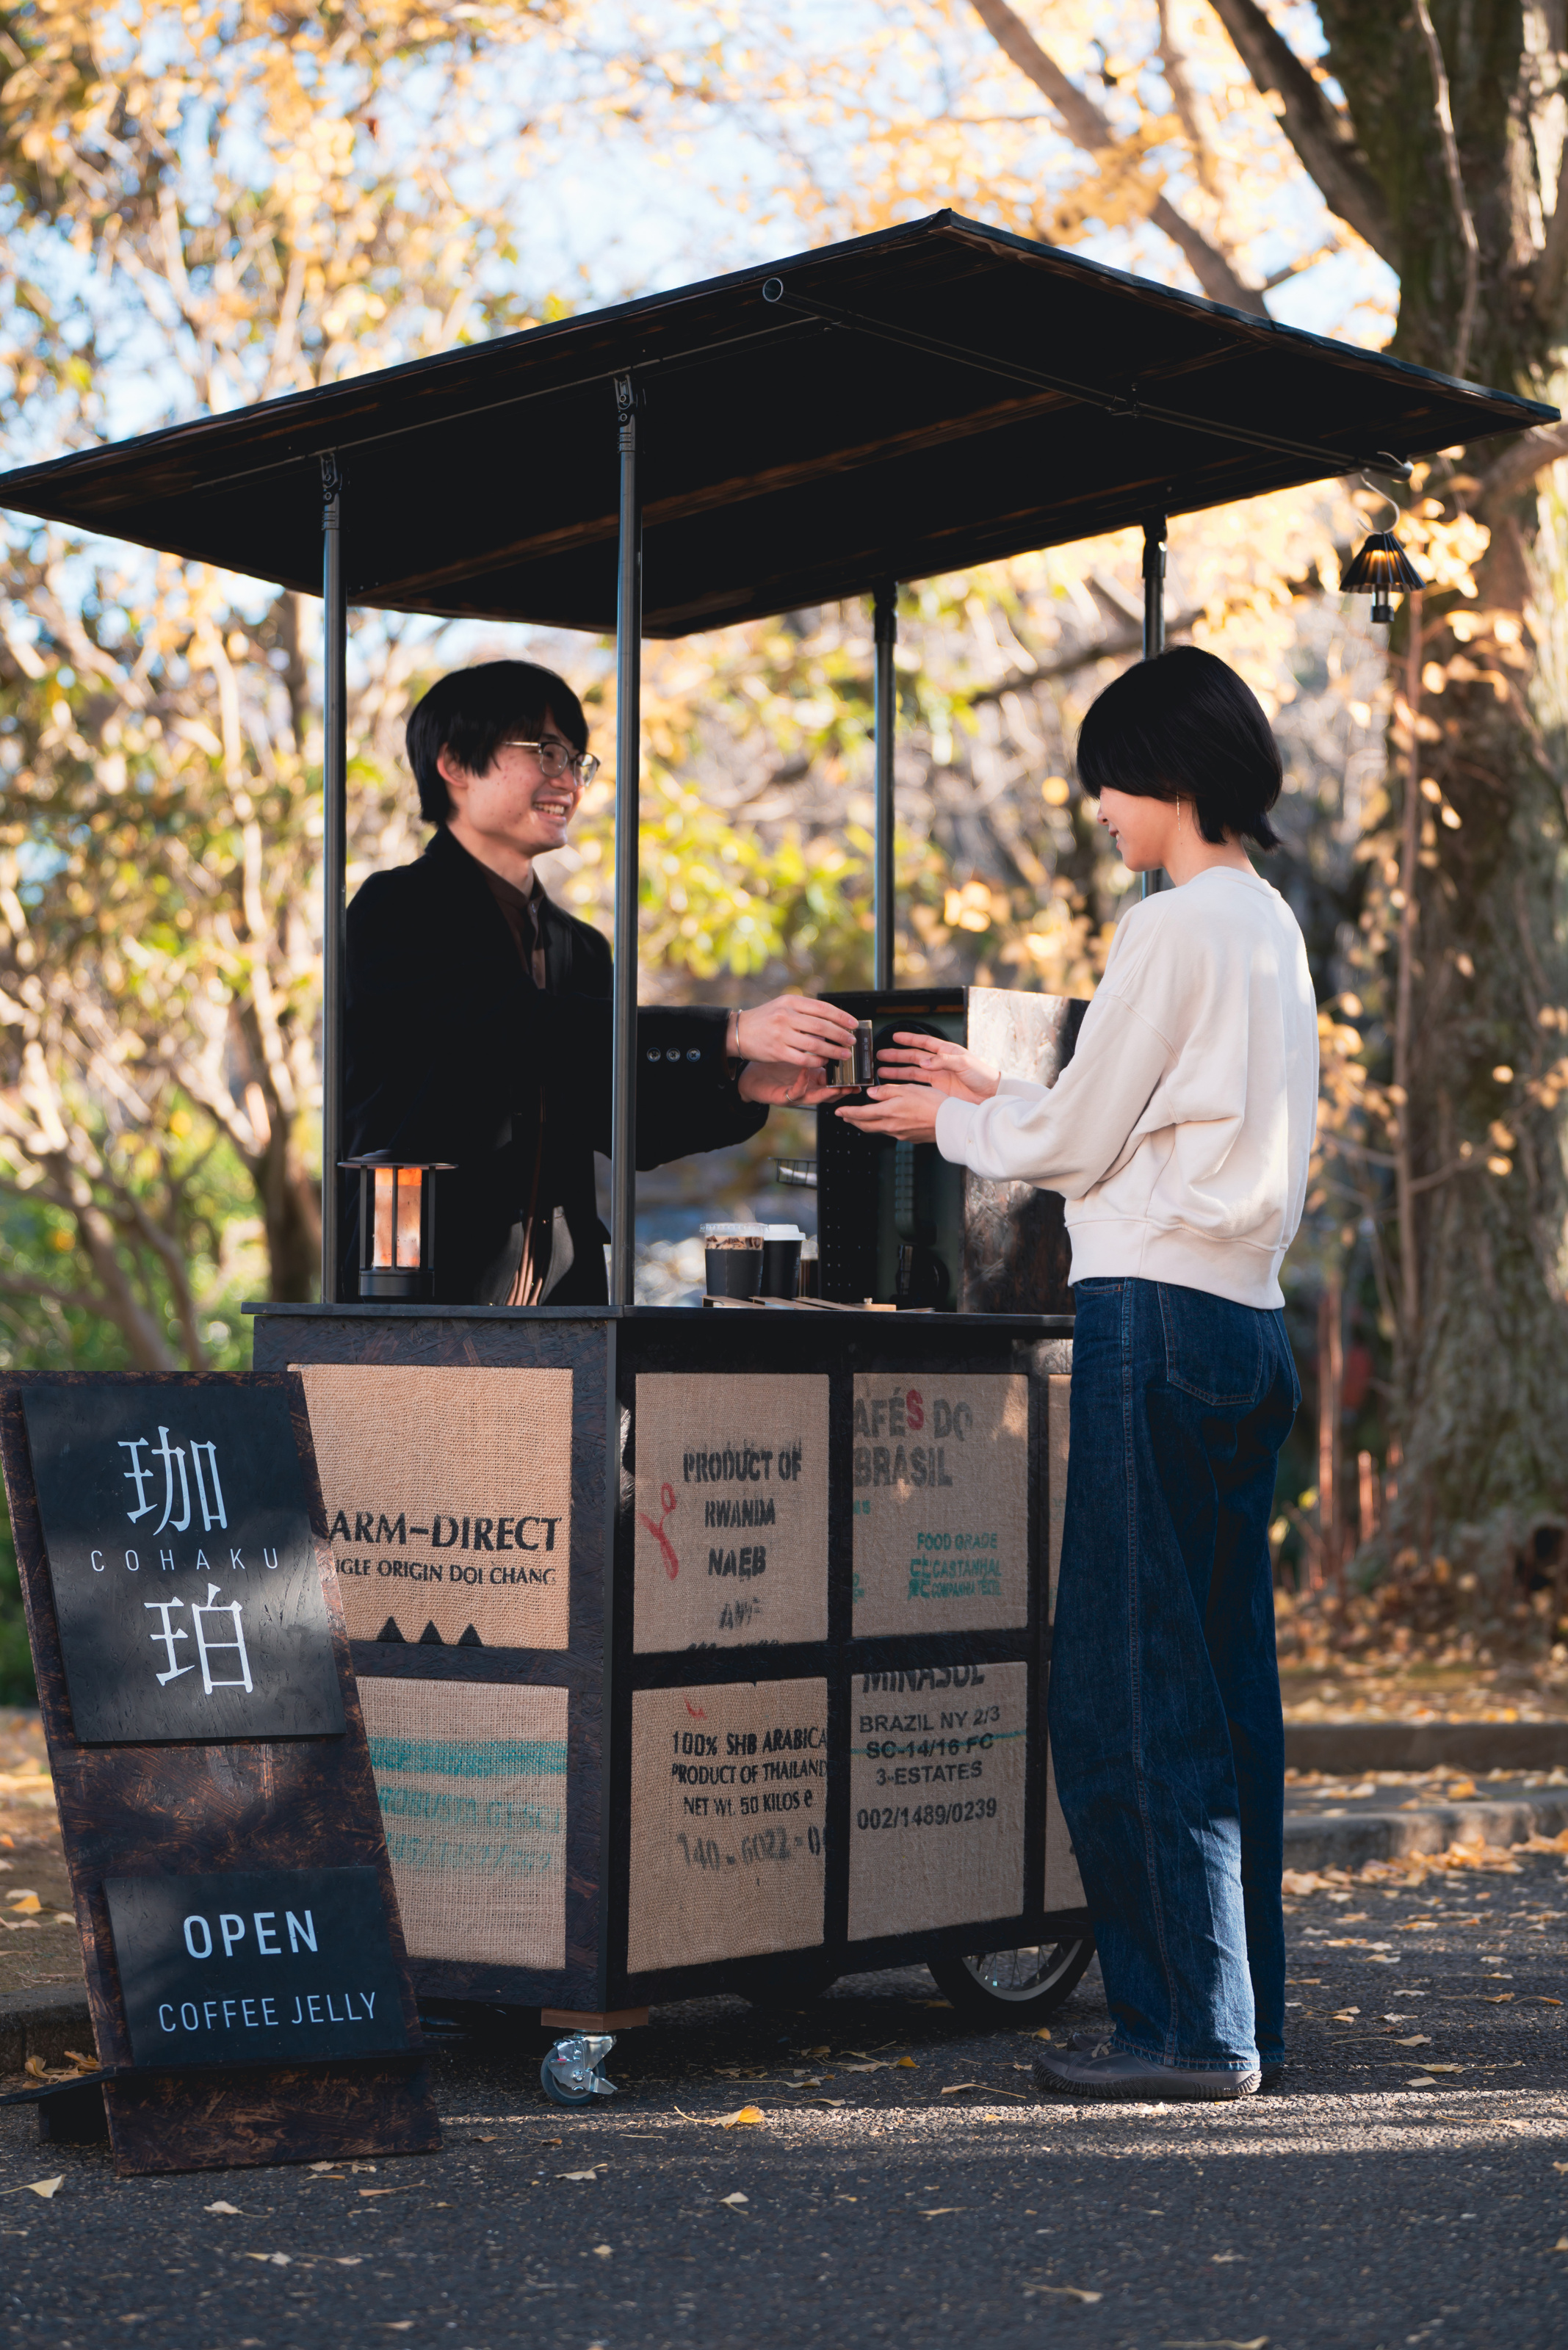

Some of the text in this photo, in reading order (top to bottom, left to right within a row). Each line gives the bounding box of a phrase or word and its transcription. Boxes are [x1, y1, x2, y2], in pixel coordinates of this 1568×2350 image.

[683, 1448, 802, 1482] PRODUCT OF
[853, 1445, 953, 1487] BRASIL
[118, 1425, 228, 1536] 珈
[325, 1508, 562, 1551] ARM-DIRECT
[917, 1532, 952, 1550] FOOD
[90, 1547, 278, 1572] COHAKU
[377, 1559, 442, 1582] ORIGIN
[449, 1565, 483, 1584] DOI
[490, 1566, 556, 1585] CHANG
[708, 1546, 766, 1577] NAEB
[144, 1583, 253, 1695] 珀
[859, 1705, 1001, 1733] BRAZIL NY 2/3
[673, 1727, 828, 1756] 100% SHB ARABICA
[866, 1732, 994, 1760] SC-14/16 FC
[671, 1759, 828, 1785] PRODUCT OF THAILAND
[876, 1760, 983, 1786] 3-ESTATES
[684, 1796, 709, 1817] NET
[740, 1796, 759, 1815] 50
[763, 1790, 800, 1812] KILOS
[856, 1797, 997, 1831] 002/1489/0239
[183, 1909, 319, 1959] OPEN
[158, 1991, 376, 2033] COFFEE JELLY
